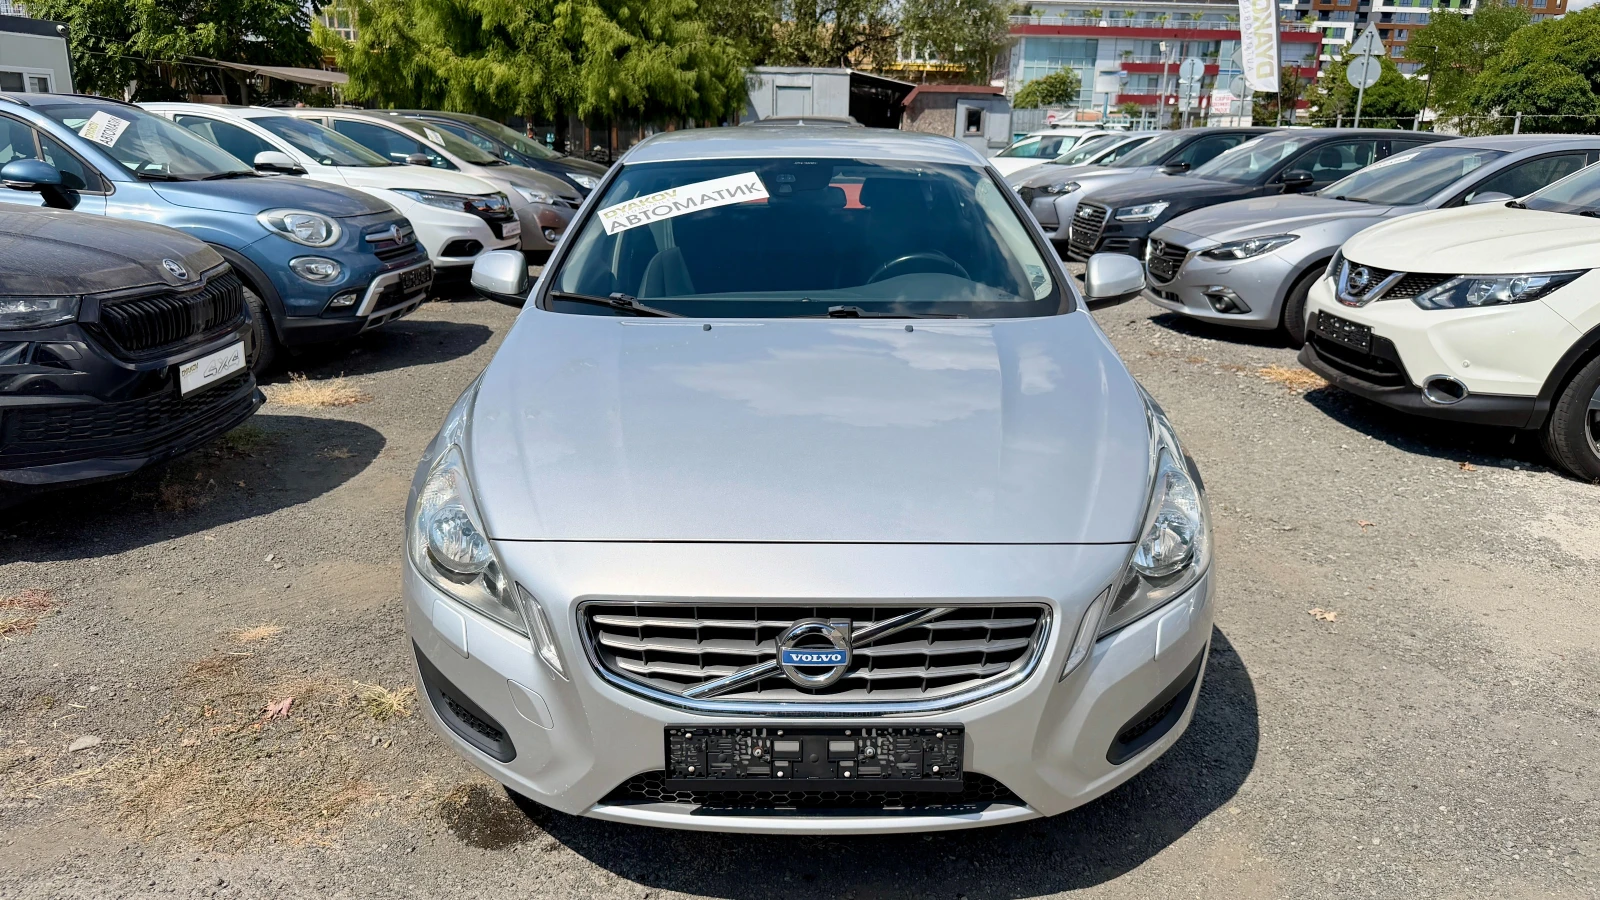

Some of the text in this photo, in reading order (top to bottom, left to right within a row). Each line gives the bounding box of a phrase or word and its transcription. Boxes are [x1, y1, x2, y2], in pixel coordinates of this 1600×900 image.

[603, 189, 677, 219] DYAKOV
[610, 182, 762, 232] АВТОМАТИК
[789, 653, 842, 662] VOLVO
